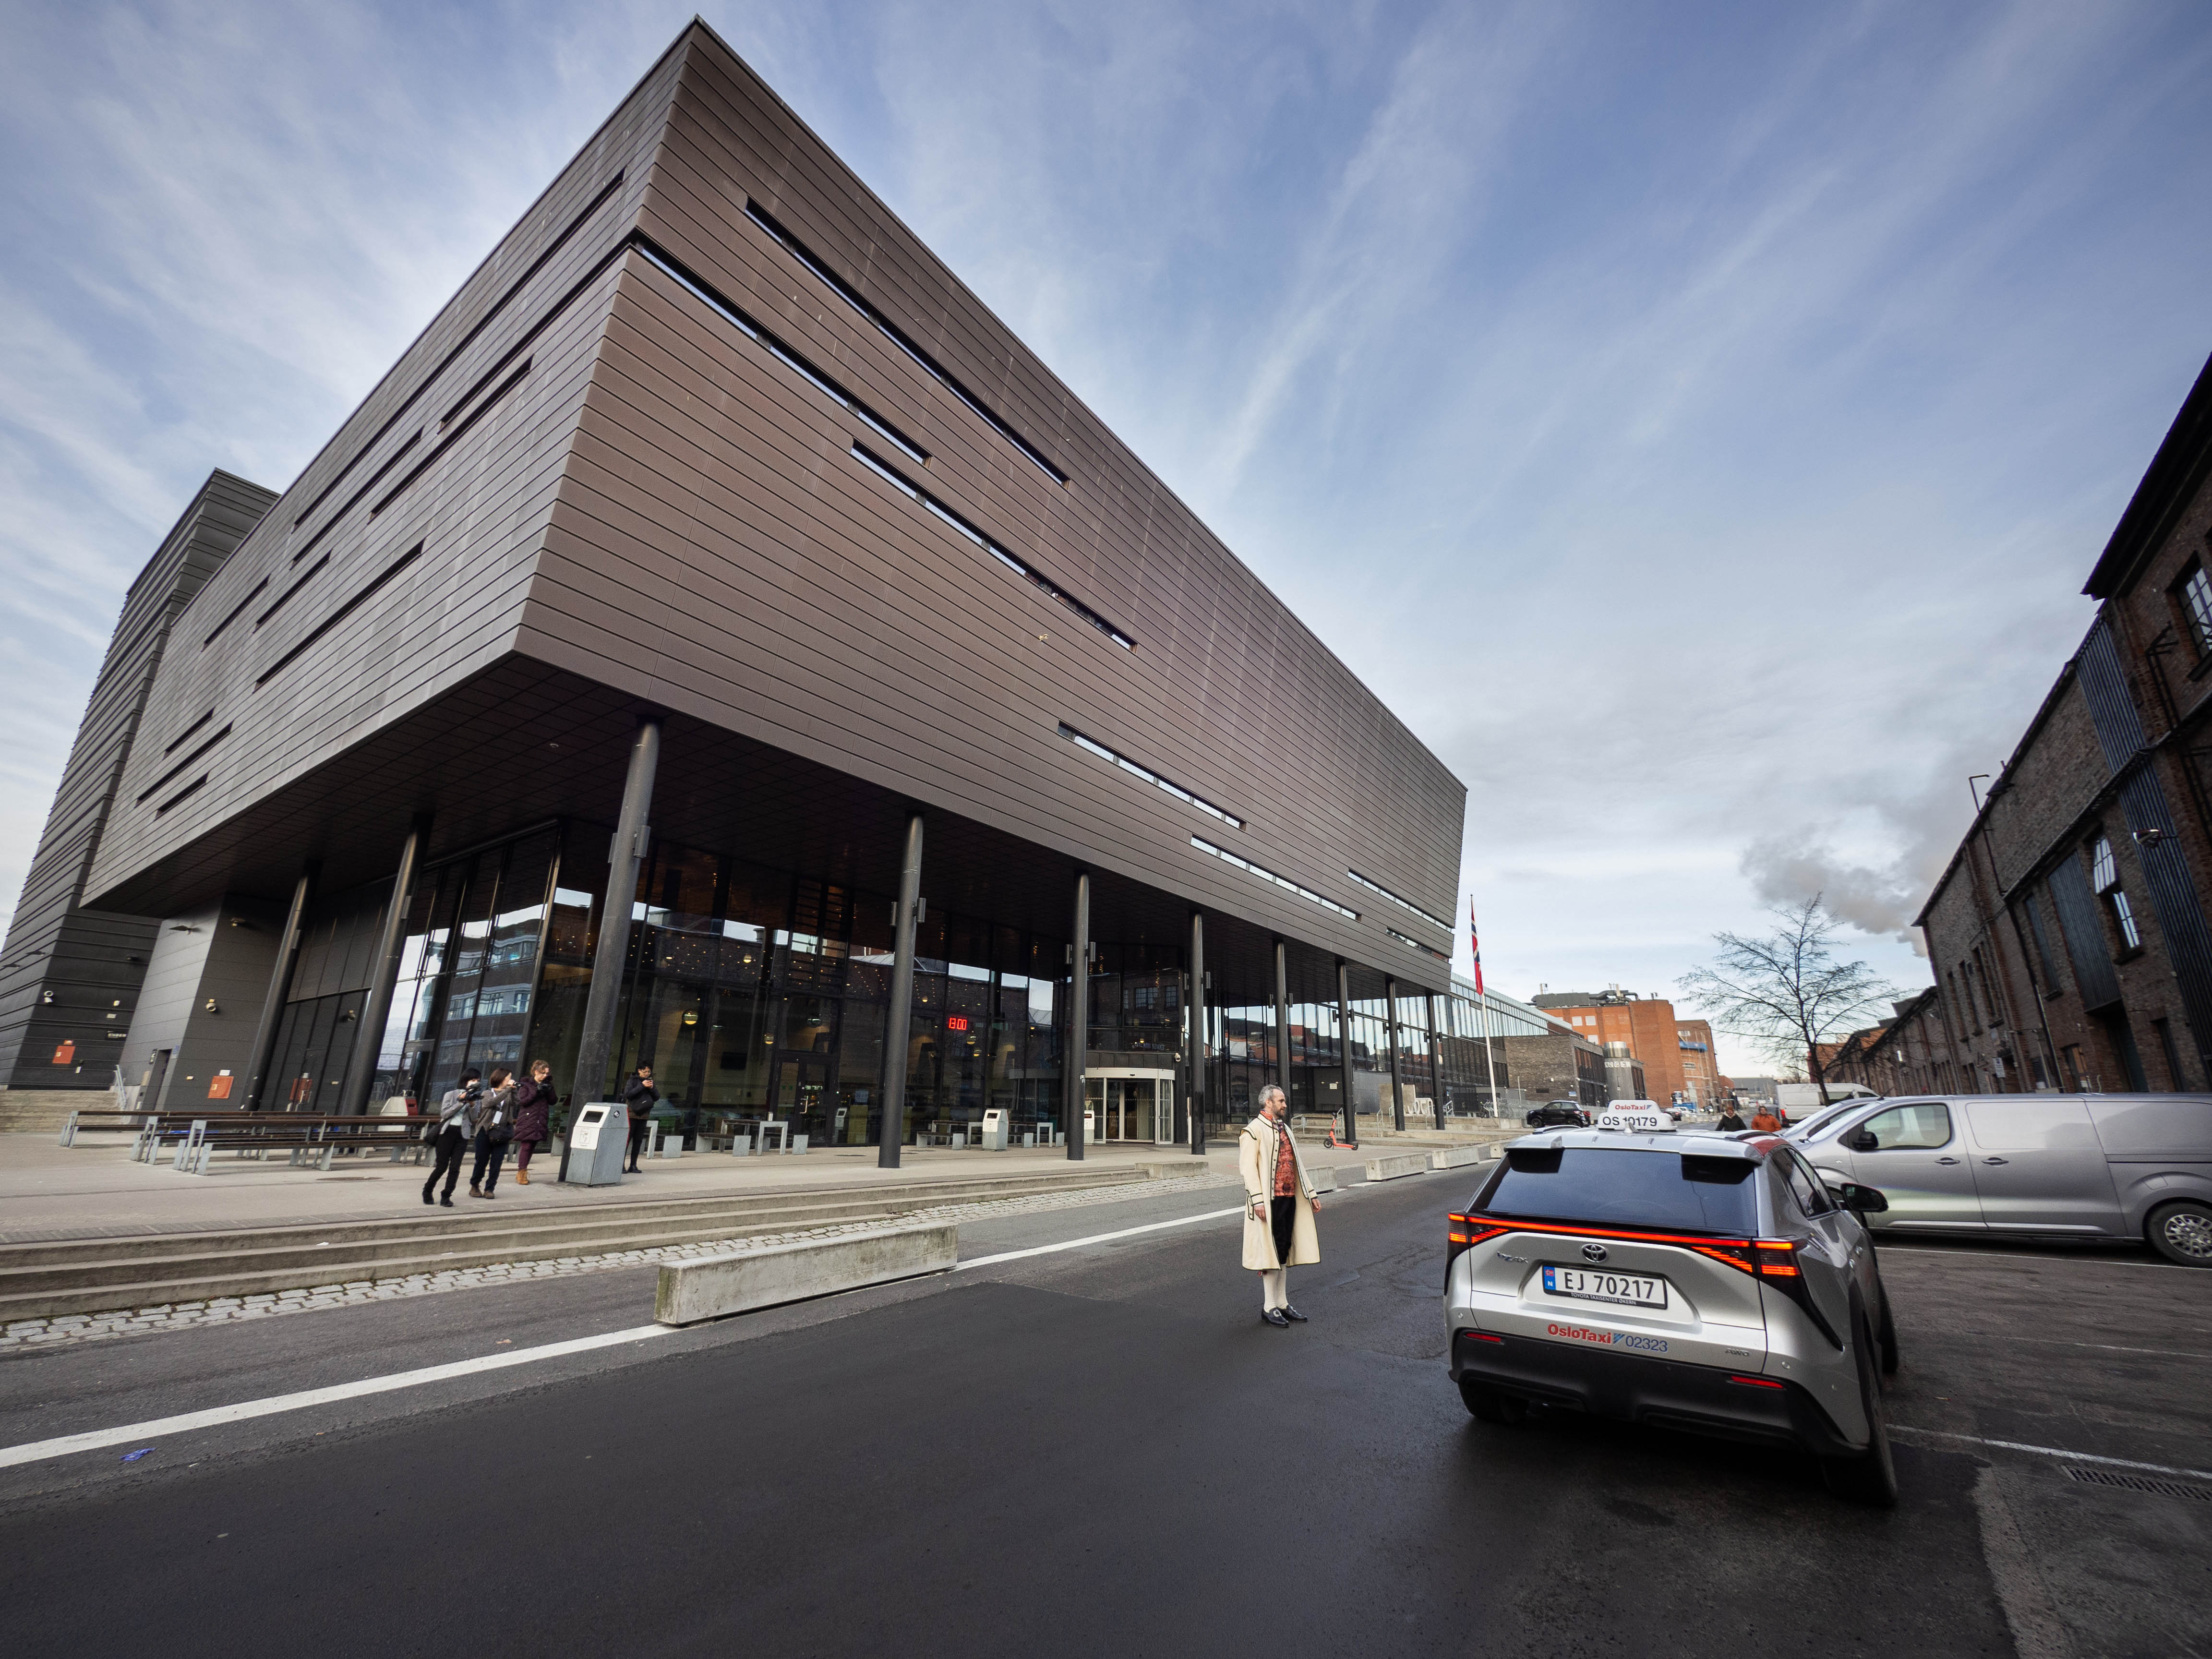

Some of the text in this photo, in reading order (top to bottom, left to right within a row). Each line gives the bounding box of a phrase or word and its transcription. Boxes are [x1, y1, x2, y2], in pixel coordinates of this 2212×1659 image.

[1602, 1117, 1620, 1126] OS
[1564, 1272, 1654, 1299] EJ 70217
[1590, 1295, 1618, 1303] TAXISENTER
[1547, 1323, 1668, 1352] OsloTaxi 02323
